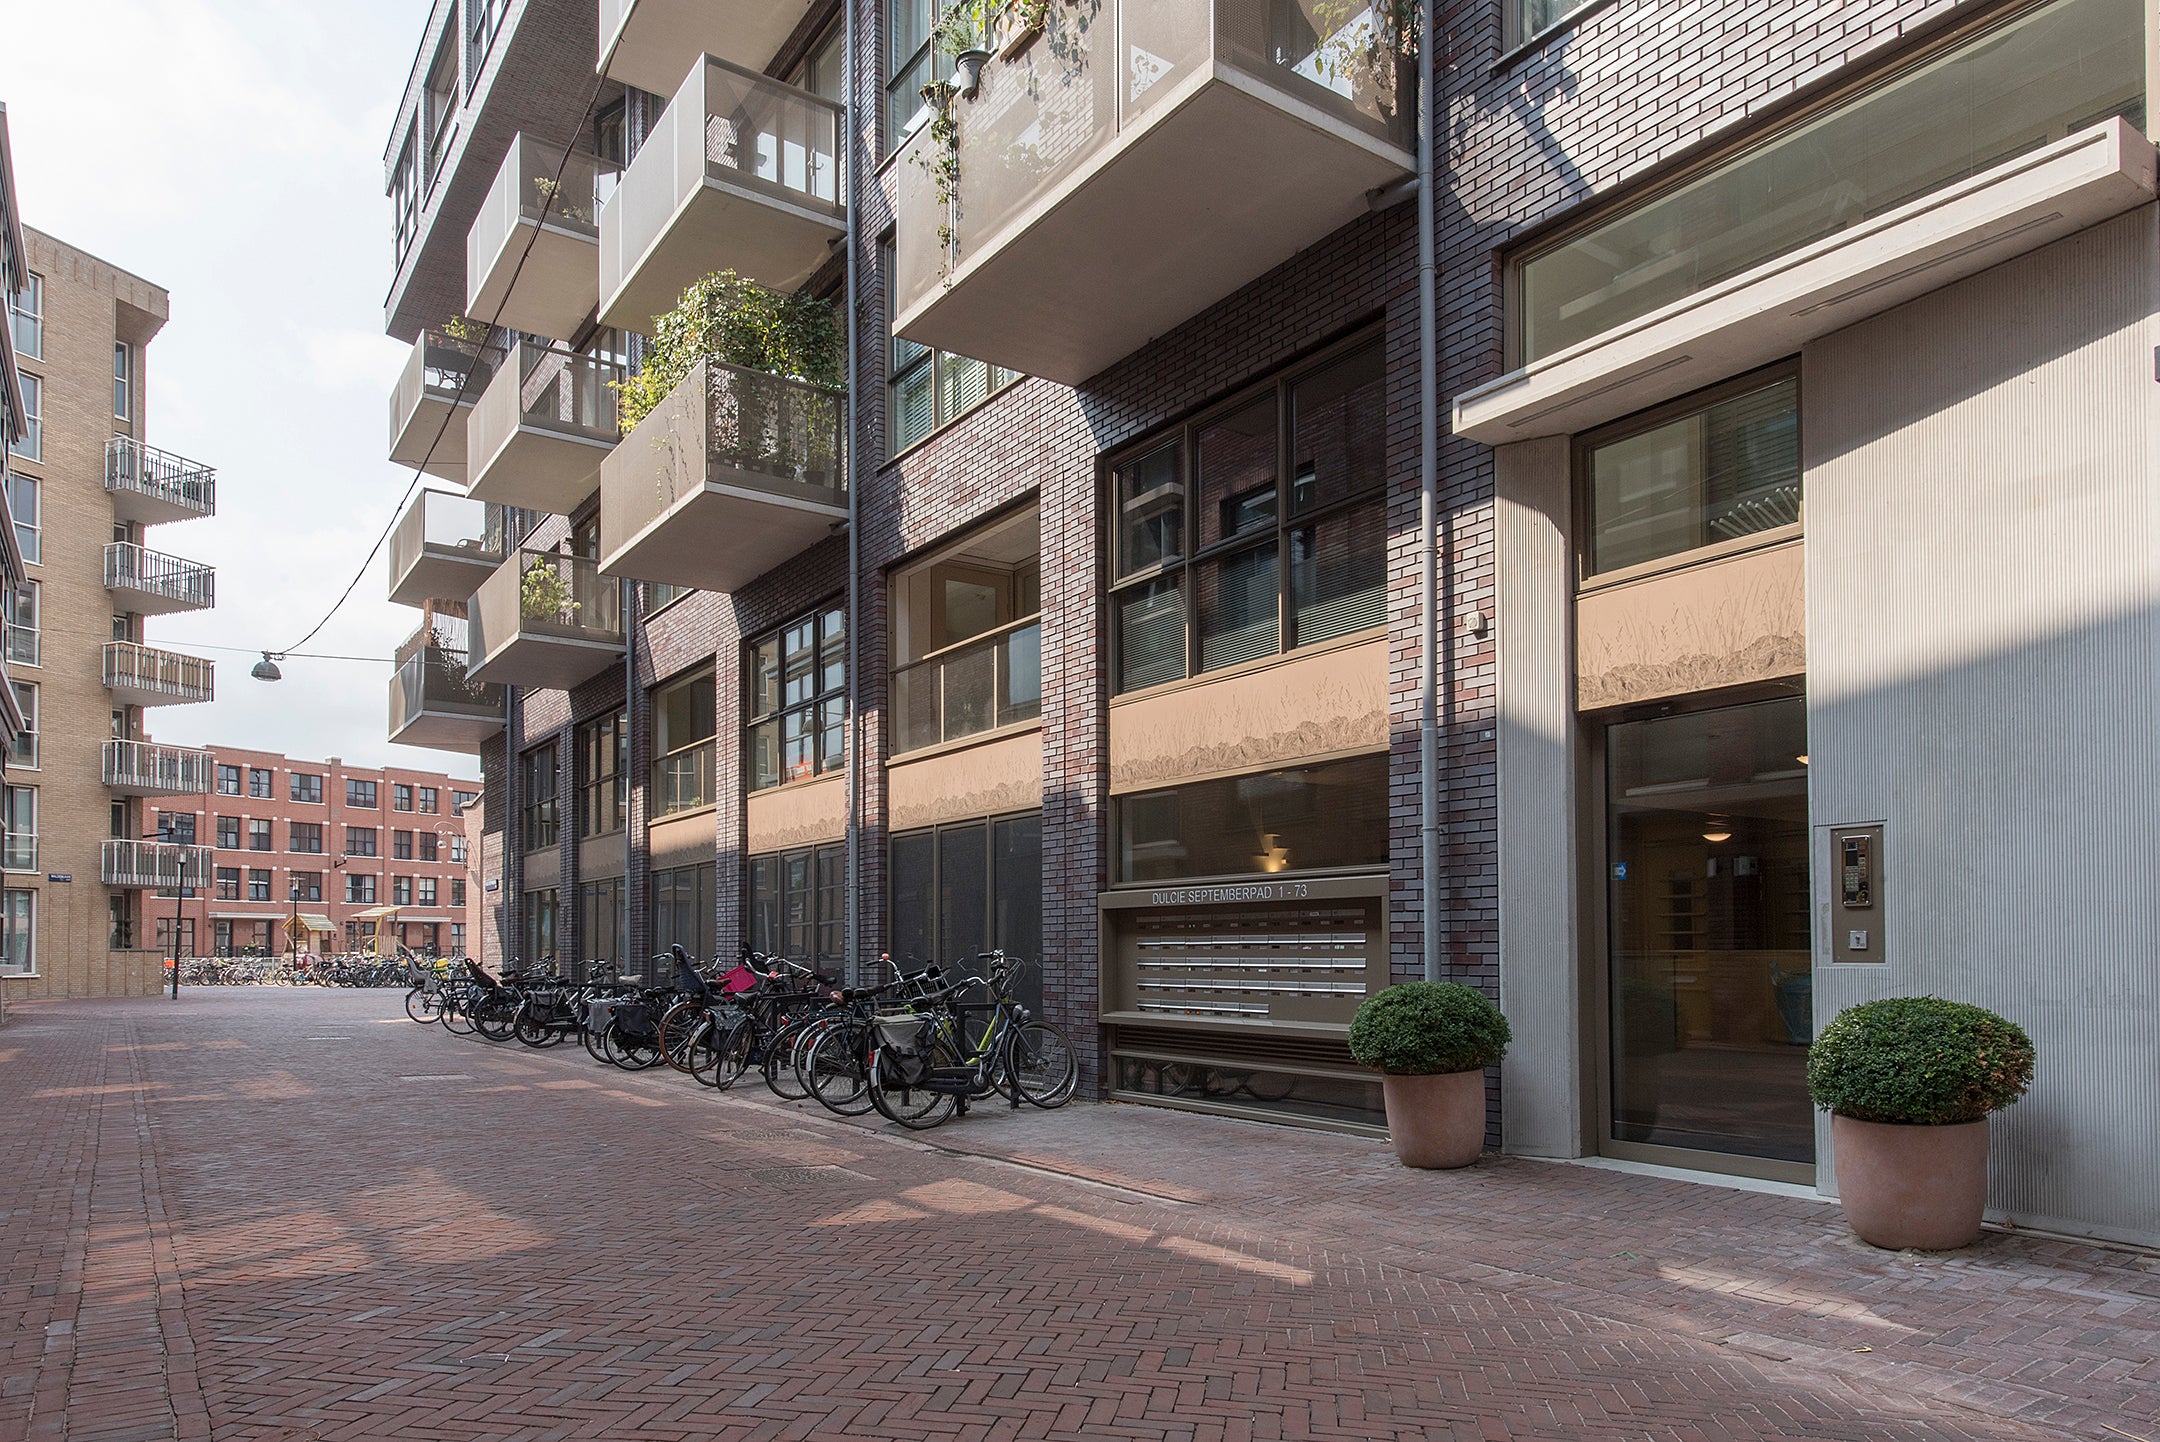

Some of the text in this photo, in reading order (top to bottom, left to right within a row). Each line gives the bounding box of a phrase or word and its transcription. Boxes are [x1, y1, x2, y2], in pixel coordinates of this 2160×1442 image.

[1152, 891, 1186, 904] DULCIE
[1188, 886, 1272, 903] SEPTEMBERPAD
[1279, 885, 1283, 898] 1
[1294, 884, 1308, 897] 73
